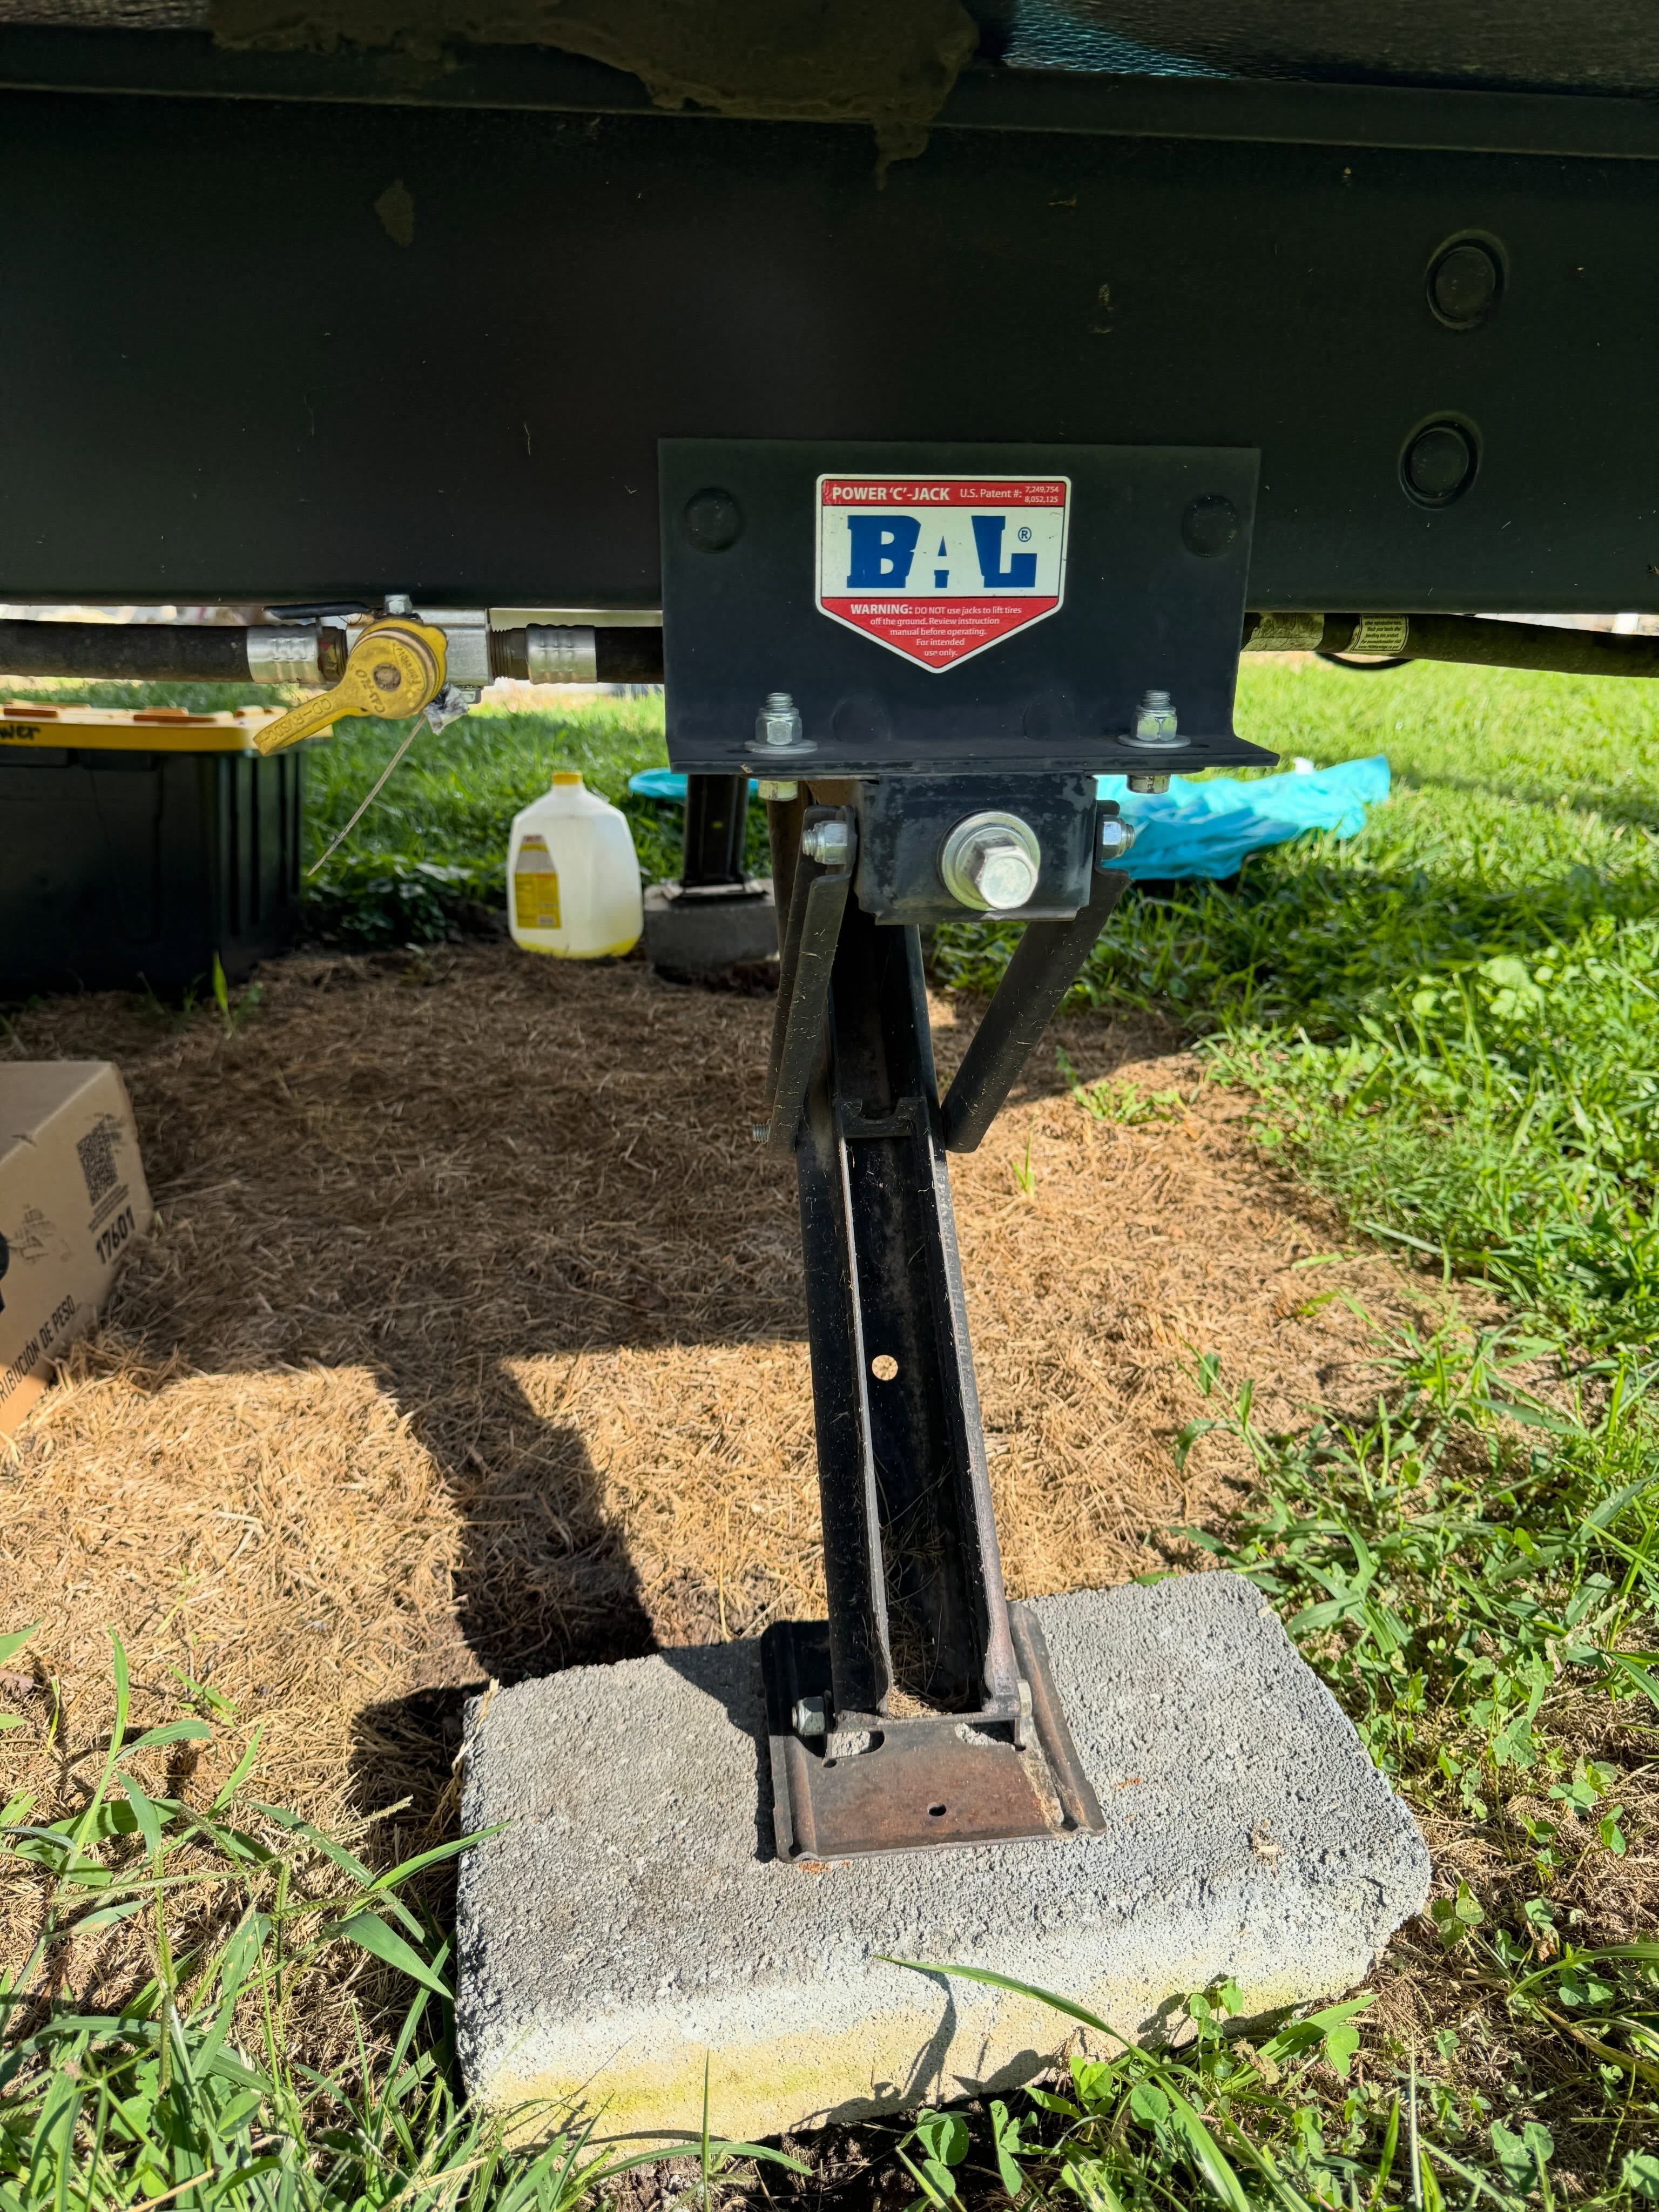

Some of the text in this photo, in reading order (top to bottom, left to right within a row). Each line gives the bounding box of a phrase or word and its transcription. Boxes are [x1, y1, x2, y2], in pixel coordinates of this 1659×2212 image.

[832, 487, 887, 500] POWER
[960, 488, 1022, 498] U.S. Patent #:
[851, 604, 912, 615] WARNING:
[961, 606, 981, 616] jacks
[897, 617, 929, 626] ground.
[958, 617, 1000, 625] instruction
[890, 628, 987, 637] manual before operating.
[930, 638, 965, 646] intended
[939, 649, 957, 658] only.
[96, 1205, 136, 1265] 17601
[38, 1321, 54, 1349] DE
[51, 1294, 76, 1333] PESO
